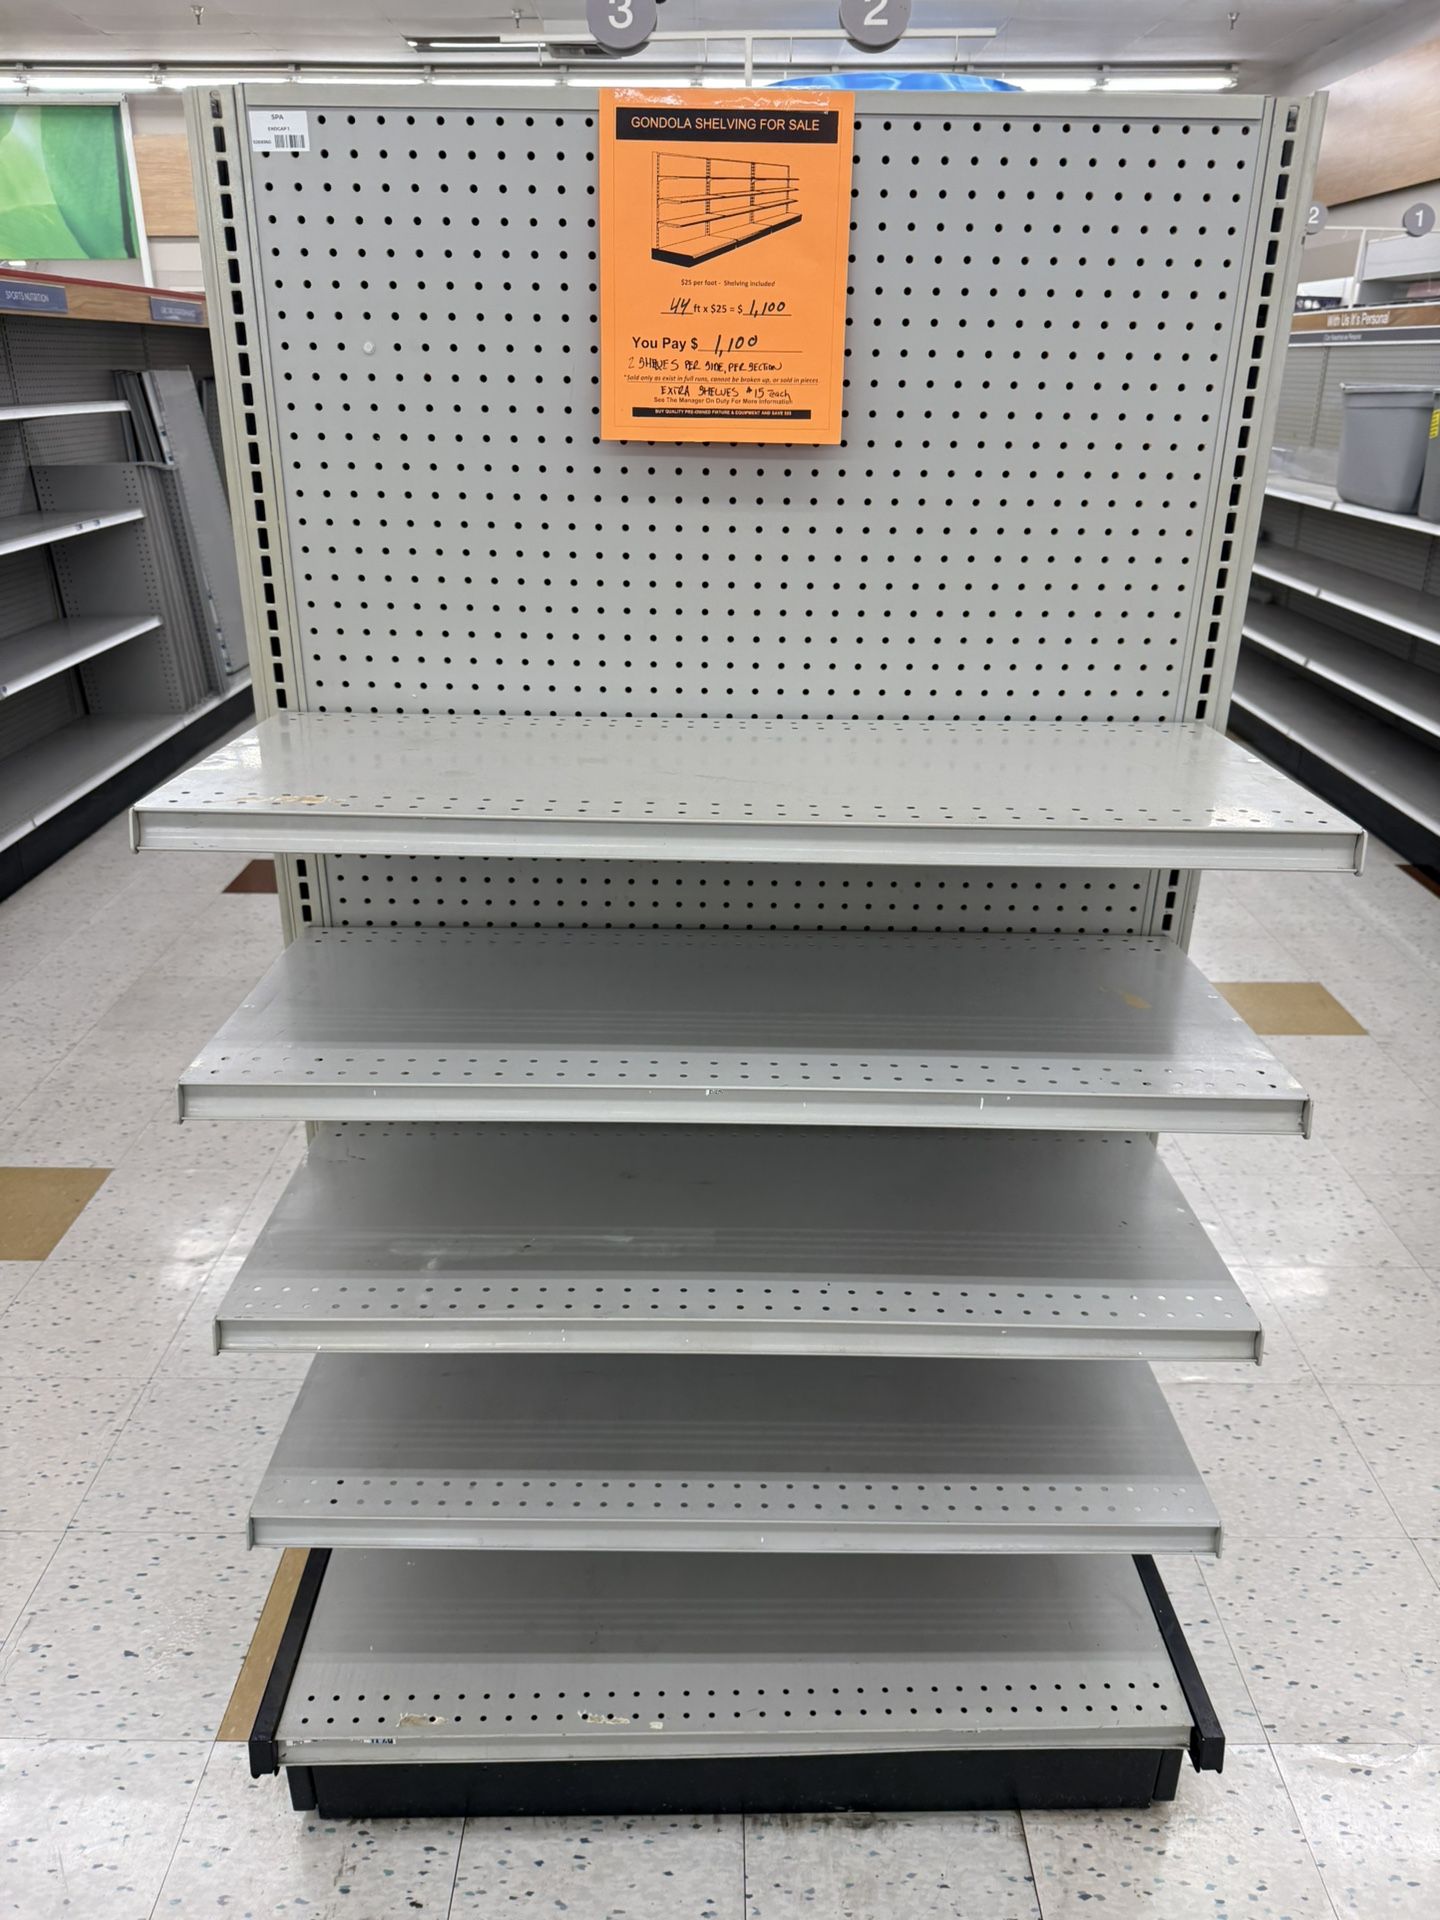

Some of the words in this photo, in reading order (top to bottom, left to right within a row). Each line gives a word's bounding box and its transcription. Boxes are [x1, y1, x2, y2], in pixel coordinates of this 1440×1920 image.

[608, 0, 632, 28] 3
[863, 0, 888, 26] 2
[630, 116, 692, 129] GONDOLA
[695, 117, 756, 130] SHELVING
[760, 118, 785, 131] FOR
[788, 119, 820, 131] SALE
[1308, 206, 1320, 224] 2
[1416, 210, 1424, 227] 1
[670, 297, 691, 315] 44
[693, 304, 700, 313] ft
[711, 304, 727, 314] $25
[738, 304, 743, 314] $
[749, 299, 786, 318] 1,100
[1361, 311, 1391, 325] Personal
[632, 336, 658, 349] You
[662, 337, 687, 352] Pay
[690, 337, 698, 350] $
[714, 334, 758, 358] 1,100
[684, 360, 701, 371] PER
[728, 362, 746, 372] PER
[660, 385, 690, 397] EXTRA
